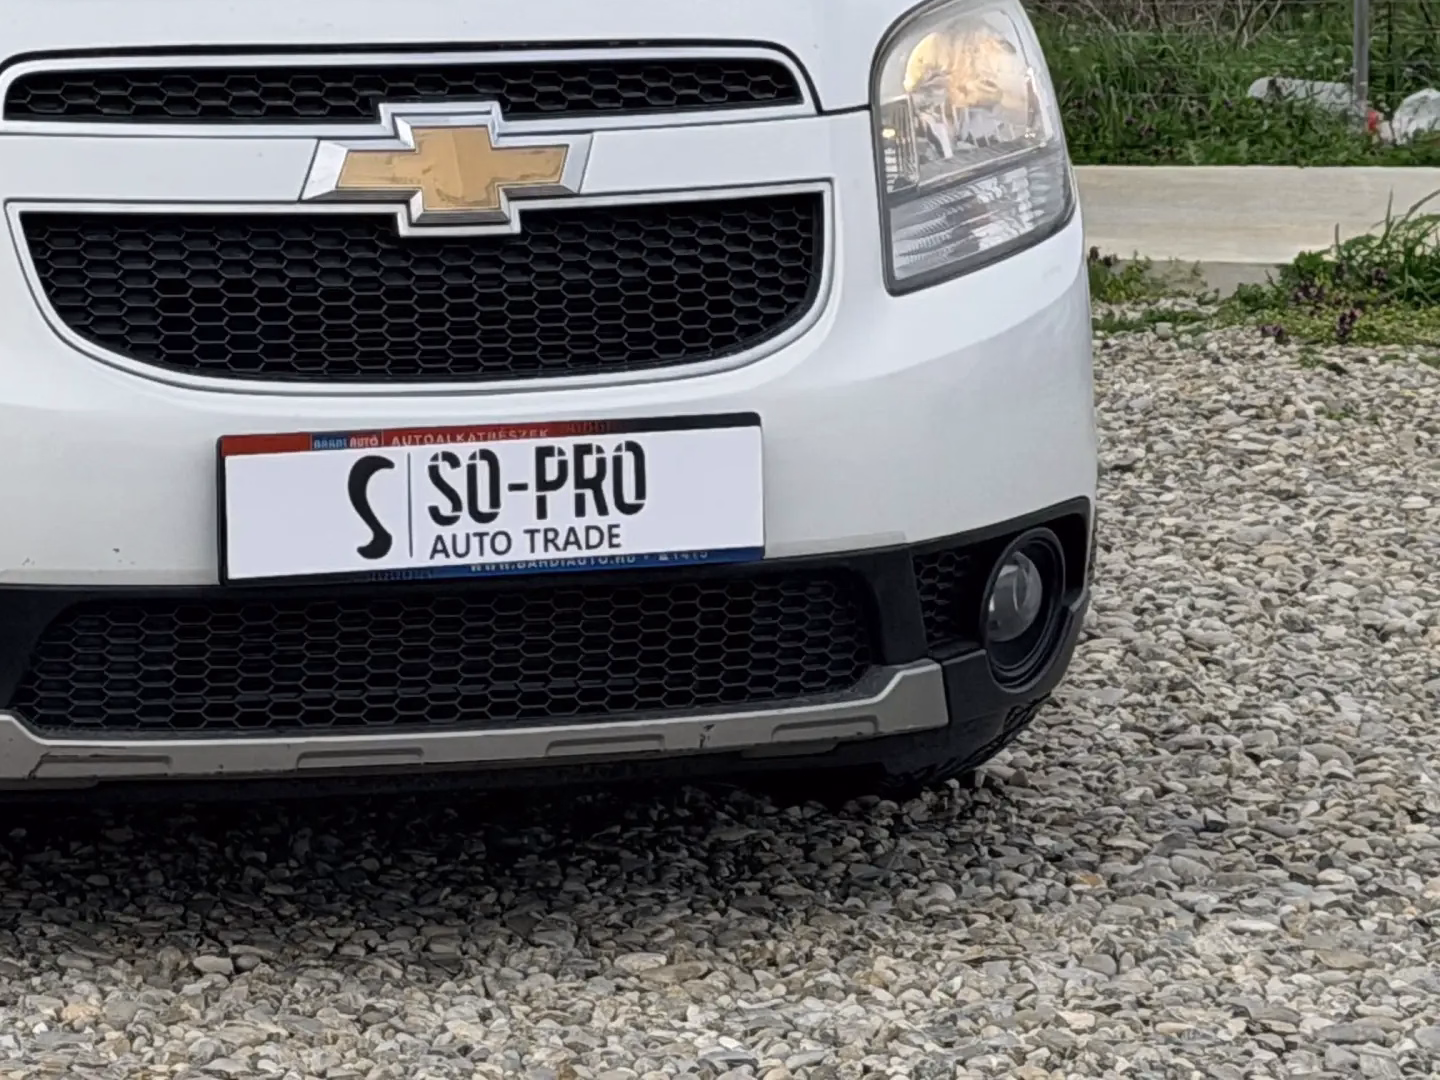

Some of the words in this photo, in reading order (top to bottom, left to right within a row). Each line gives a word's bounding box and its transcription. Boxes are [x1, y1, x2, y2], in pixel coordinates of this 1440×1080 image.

[426, 439, 647, 527] SO-PRO
[428, 530, 514, 561] AUTO
[523, 523, 623, 556] TRADE
